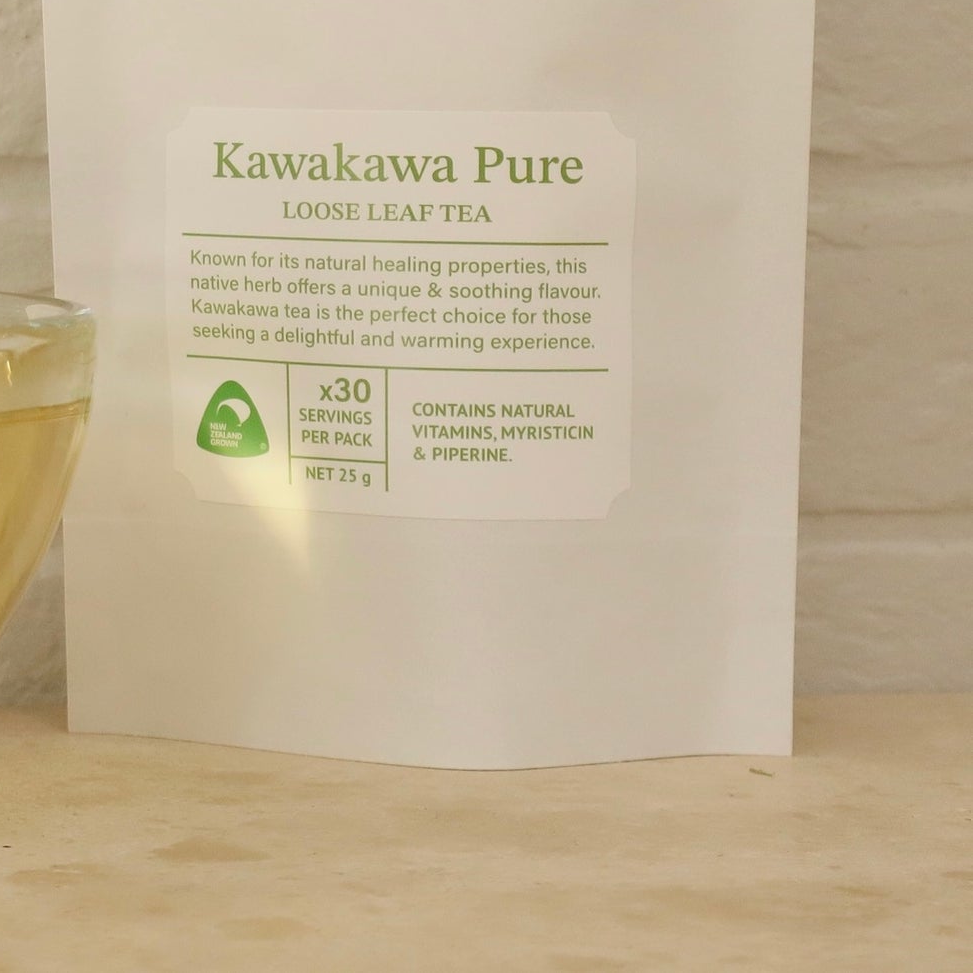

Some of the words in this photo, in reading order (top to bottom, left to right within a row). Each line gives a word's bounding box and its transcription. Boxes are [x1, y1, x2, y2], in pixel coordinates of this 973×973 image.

[213, 141, 458, 183] Kawakawa
[474, 146, 583, 184] Pure
[283, 201, 360, 220] LOOSE
[368, 203, 433, 221] LEAF
[440, 205, 492, 223] TEA
[190, 250, 247, 267] Known
[251, 251, 274, 269] for
[279, 252, 300, 269] its
[305, 254, 366, 272] natural
[373, 255, 441, 276] healing
[448, 258, 551, 277] properties,
[556, 258, 587, 274] this
[190, 276, 239, 291] native
[244, 277, 282, 293] herb
[287, 279, 336, 296] offers
[341, 284, 352, 296] a
[358, 282, 422, 301] unique
[427, 283, 443, 298] &
[449, 282, 532, 303] soothing
[538, 282, 601, 299] flavour.
[191, 299, 279, 318] Kawakawa
[284, 304, 311, 319] tea
[316, 304, 330, 320] is
[335, 305, 364, 321] the
[369, 306, 436, 325] perfect
[442, 308, 506, 325] choice
[511, 308, 538, 325] for
[542, 308, 592, 325] those
[192, 323, 255, 344] seeking
[260, 330, 270, 341] a
[274, 327, 355, 349] delightful
[360, 331, 395, 347] and
[401, 332, 484, 352] warming
[490, 334, 595, 353] experience.
[319, 377, 371, 403] x30
[299, 408, 372, 425] SERVINGS
[412, 403, 496, 418] CONTAINS
[501, 403, 575, 418] NATURAL
[302, 430, 329, 444] PER
[335, 431, 372, 447] PACK
[412, 424, 497, 442] VITAMINS,
[501, 425, 594, 440] MYRISTICIN
[413, 447, 426, 461] &
[432, 448, 513, 462] PIPERINE.
[306, 466, 335, 480] NET
[339, 469, 356, 482] 25
[362, 473, 371, 487] g
